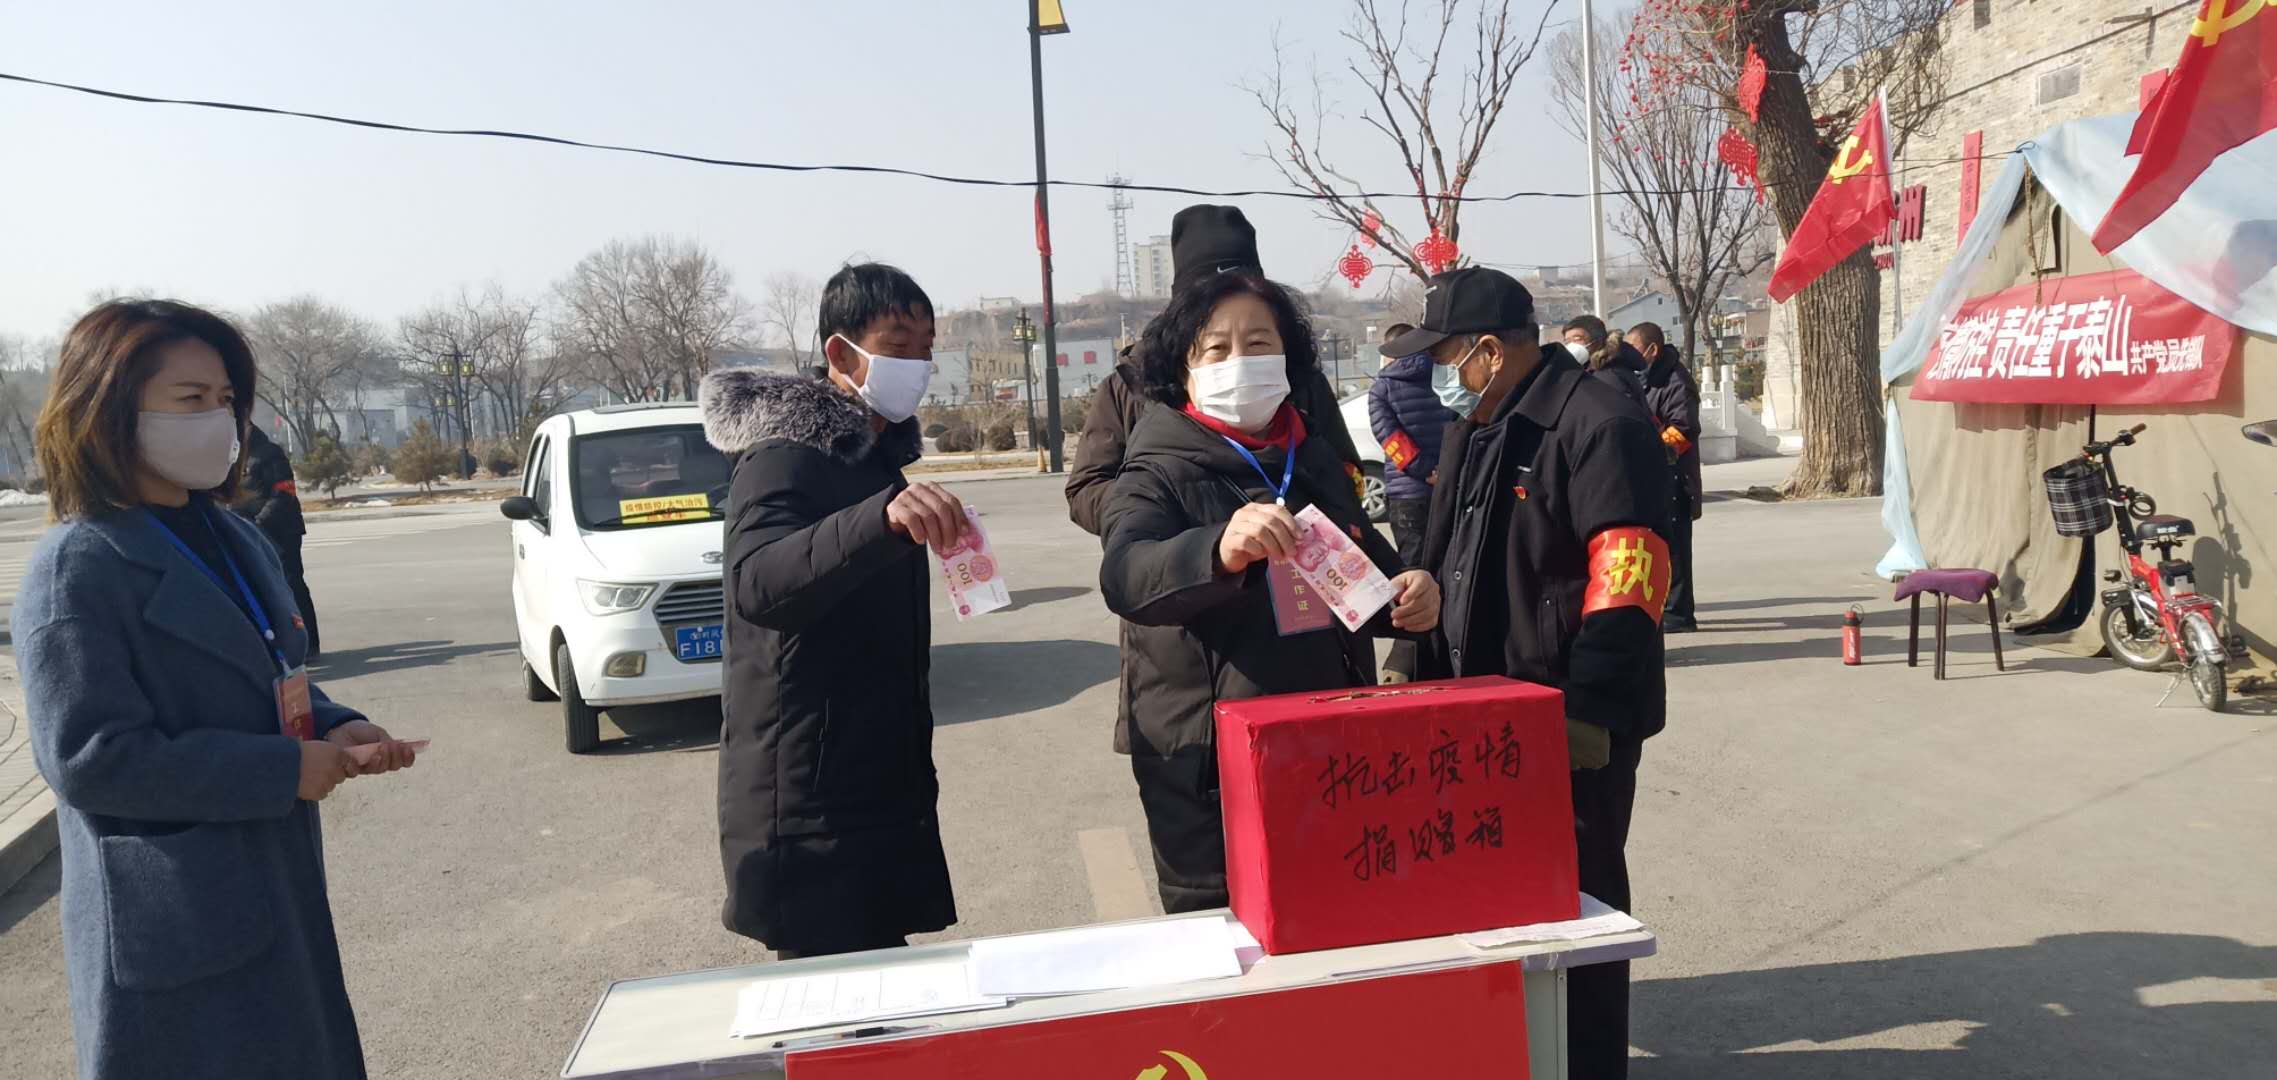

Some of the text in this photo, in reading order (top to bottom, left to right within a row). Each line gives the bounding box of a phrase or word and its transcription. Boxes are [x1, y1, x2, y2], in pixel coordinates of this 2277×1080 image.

[1987, 294, 2133, 380] 责任重于泰山
[957, 562, 974, 585] 100
[1326, 568, 1348, 591] 100
[680, 640, 723, 656] F18
[1317, 721, 1521, 809] 抗击疫情
[1344, 807, 1503, 881] 捐赠箱
